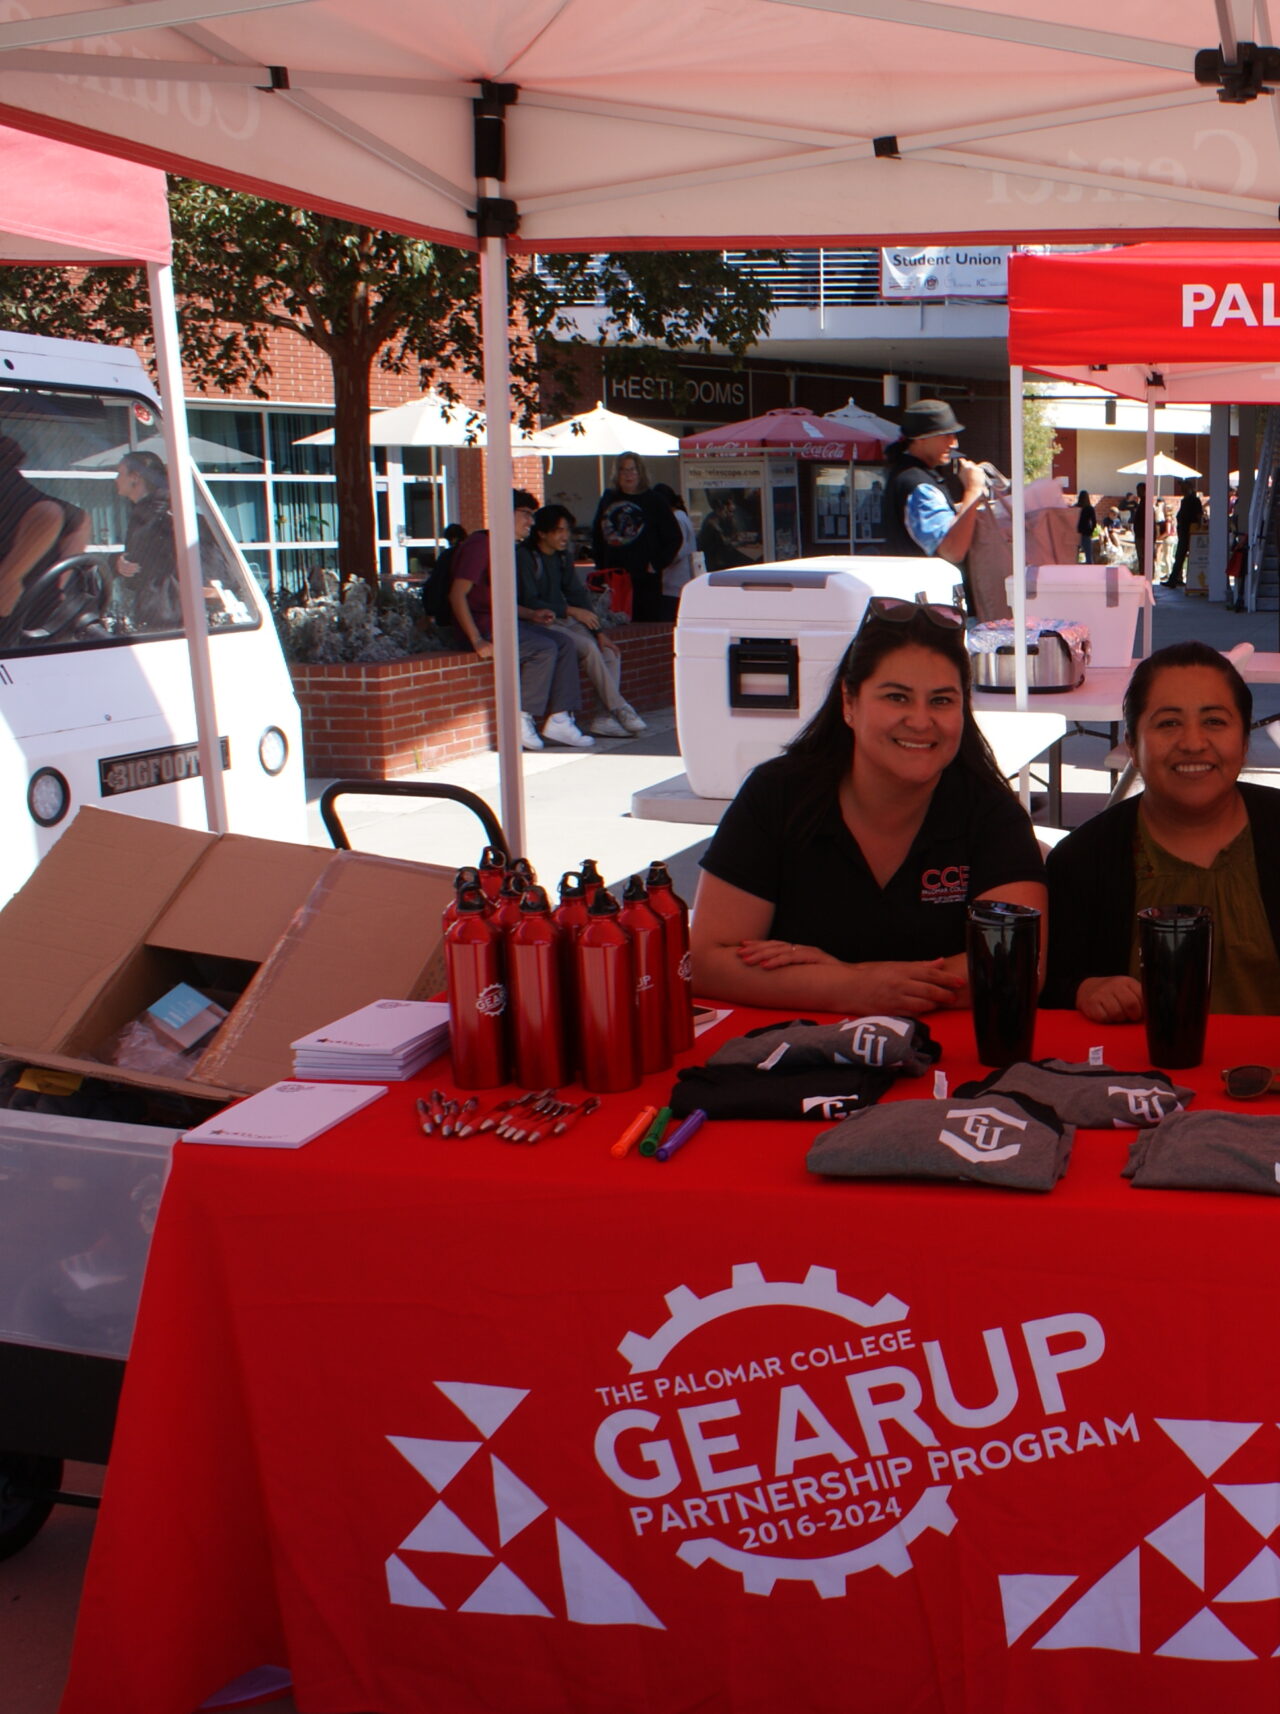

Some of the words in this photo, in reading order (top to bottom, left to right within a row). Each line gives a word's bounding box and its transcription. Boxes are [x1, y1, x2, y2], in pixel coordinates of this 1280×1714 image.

[893, 252, 950, 267] Student
[955, 252, 1002, 266] Union
[612, 375, 744, 406] RESTOOMS
[109, 751, 200, 791] BIGFOOT
[964, 1115, 1005, 1150] GU
[596, 1382, 648, 1406] THE
[655, 1357, 785, 1398] PALOMAR
[791, 1329, 916, 1372] COLLEGE
[594, 1313, 1107, 1500] GEARUP
[630, 1457, 914, 1536] PARTNERSHIP
[928, 1413, 1141, 1481] PROGRAM
[738, 1496, 902, 1551] 2016-2024
